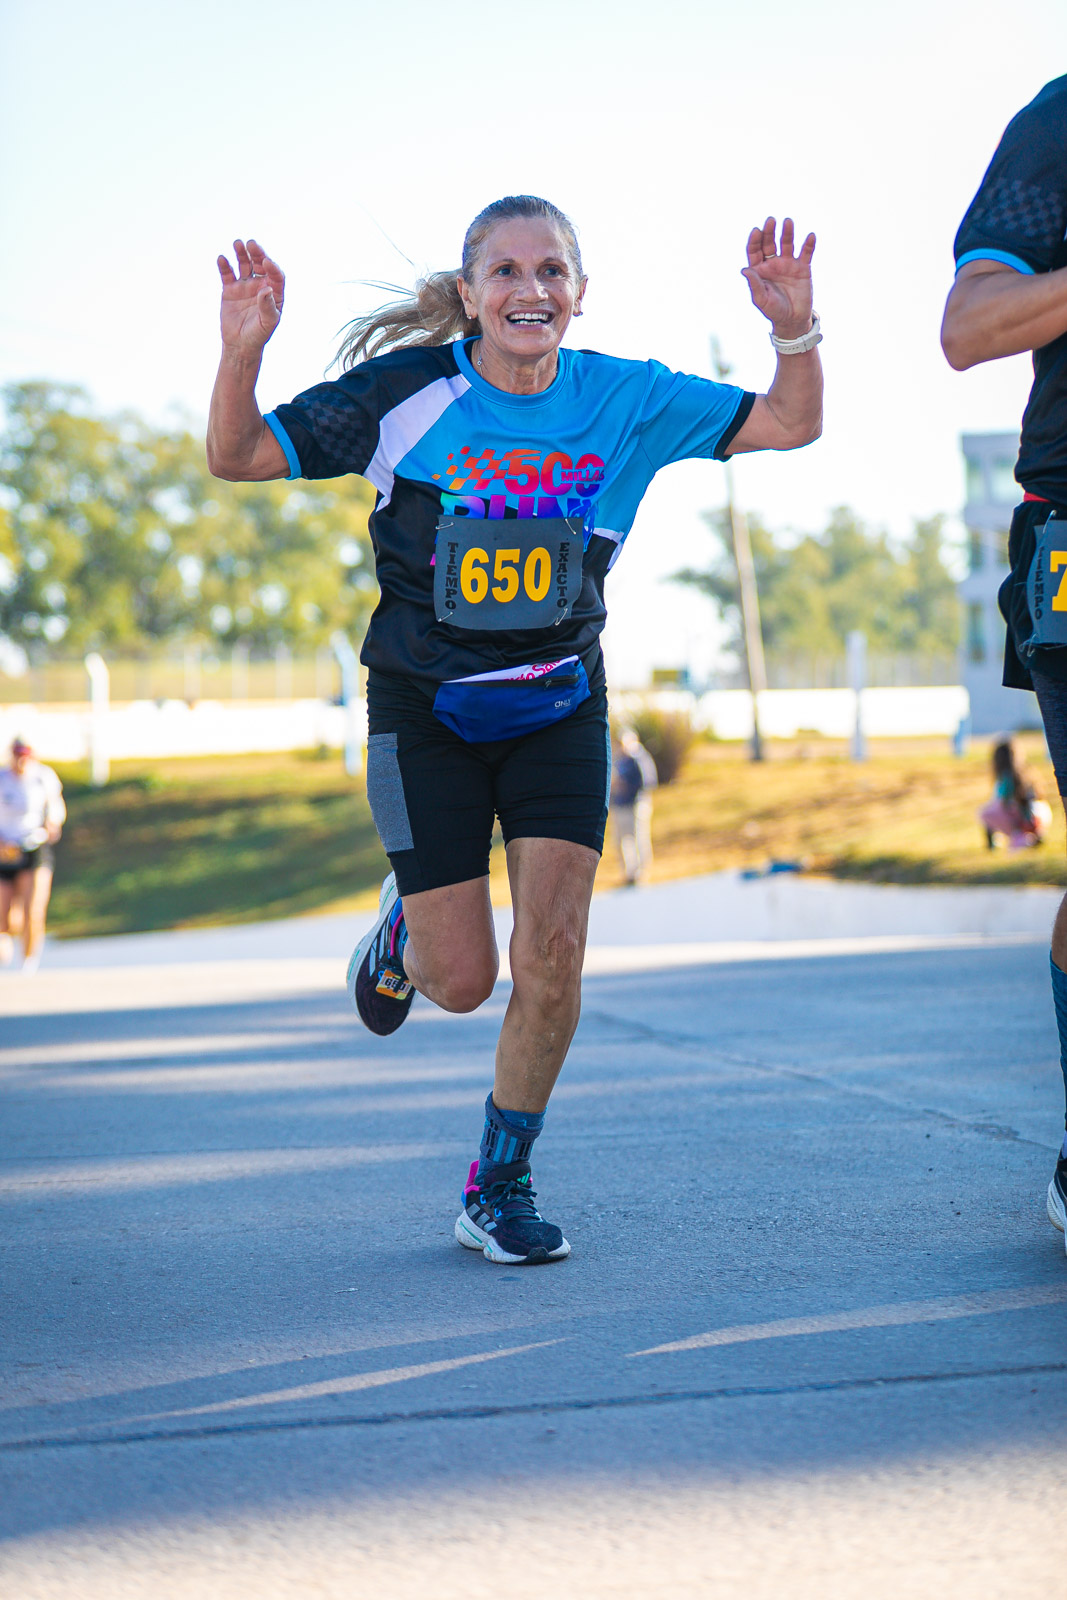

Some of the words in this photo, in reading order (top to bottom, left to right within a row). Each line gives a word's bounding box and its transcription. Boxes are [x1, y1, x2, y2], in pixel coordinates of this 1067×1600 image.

[561, 469, 605, 482] MILLAS
[446, 541, 459, 610] TIEMPO
[460, 547, 552, 604] 650
[556, 542, 570, 608] EXACTO
[1034, 546, 1045, 620] TIEMPO
